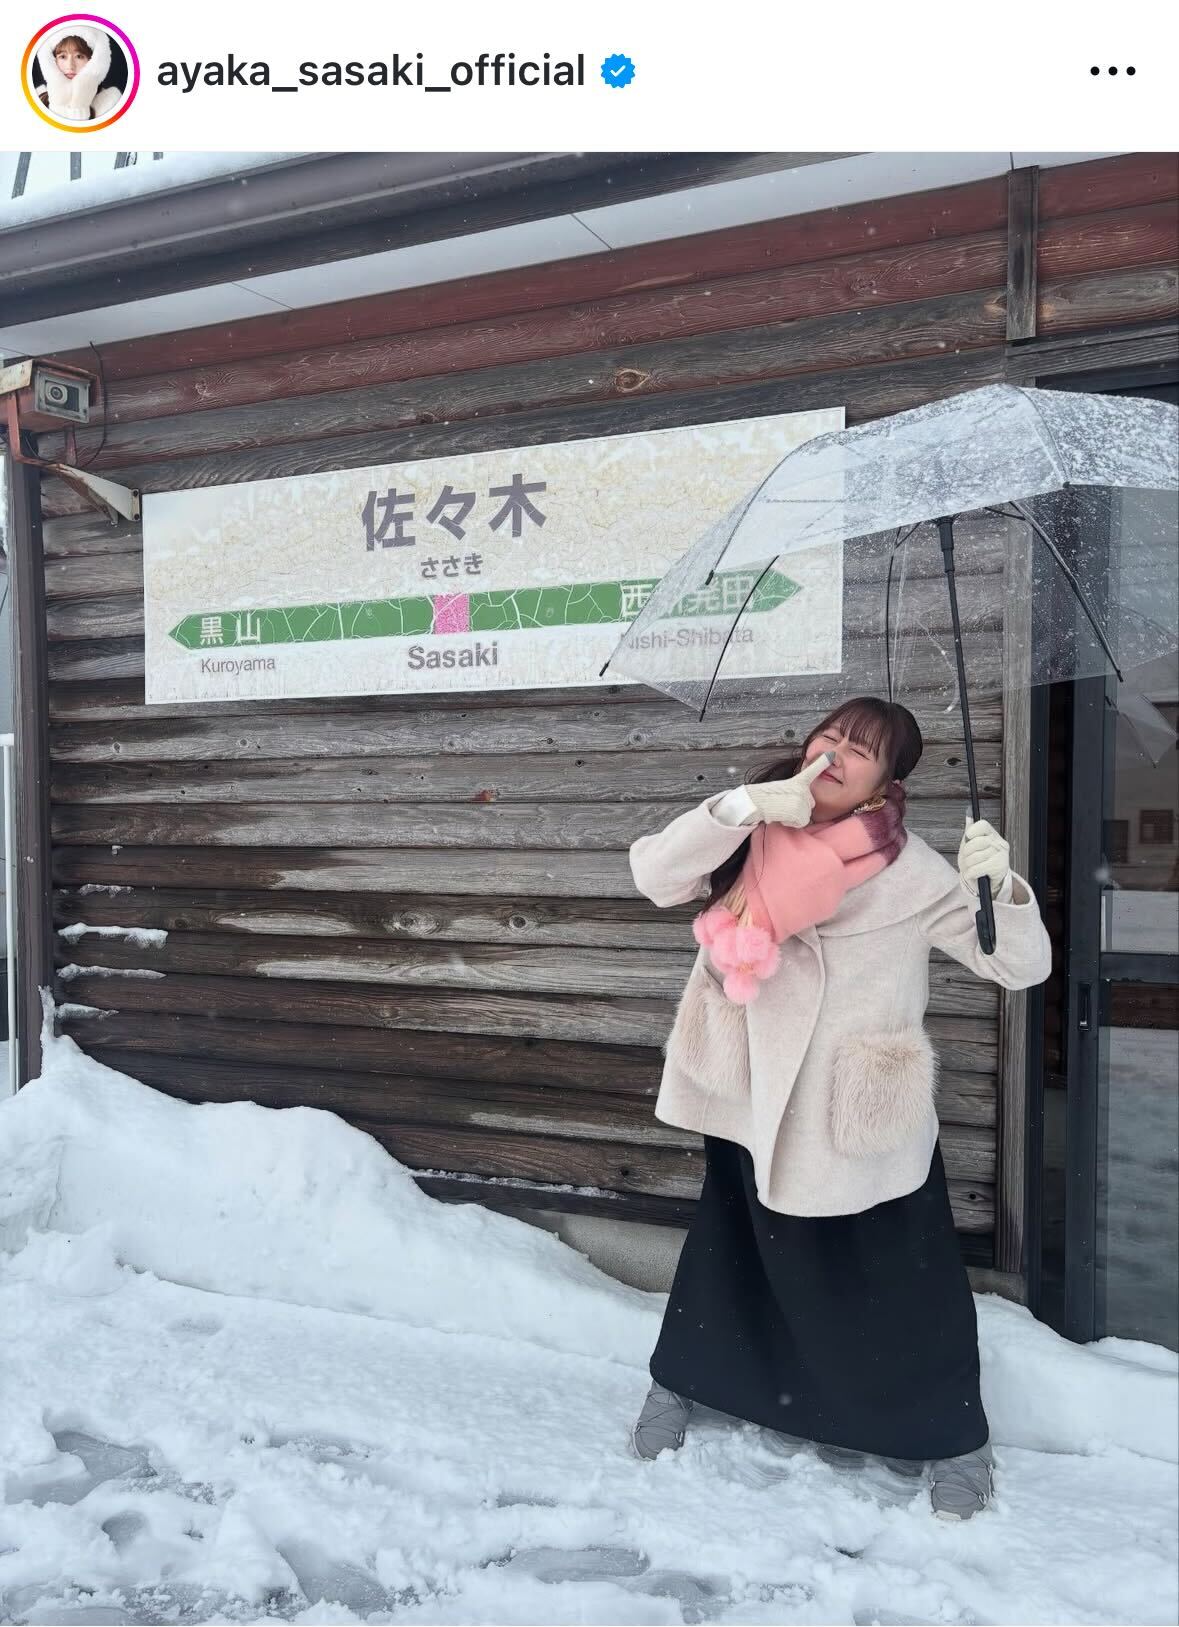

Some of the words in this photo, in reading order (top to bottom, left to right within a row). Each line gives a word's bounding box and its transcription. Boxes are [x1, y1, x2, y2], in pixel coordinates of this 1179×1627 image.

[361, 474, 548, 551] 佐々木
[420, 552, 484, 579] ささき
[621, 574, 755, 618] 西発田
[199, 614, 261, 645] 黒山
[201, 656, 276, 675] Kuroyama
[407, 643, 499, 671] Sasaki
